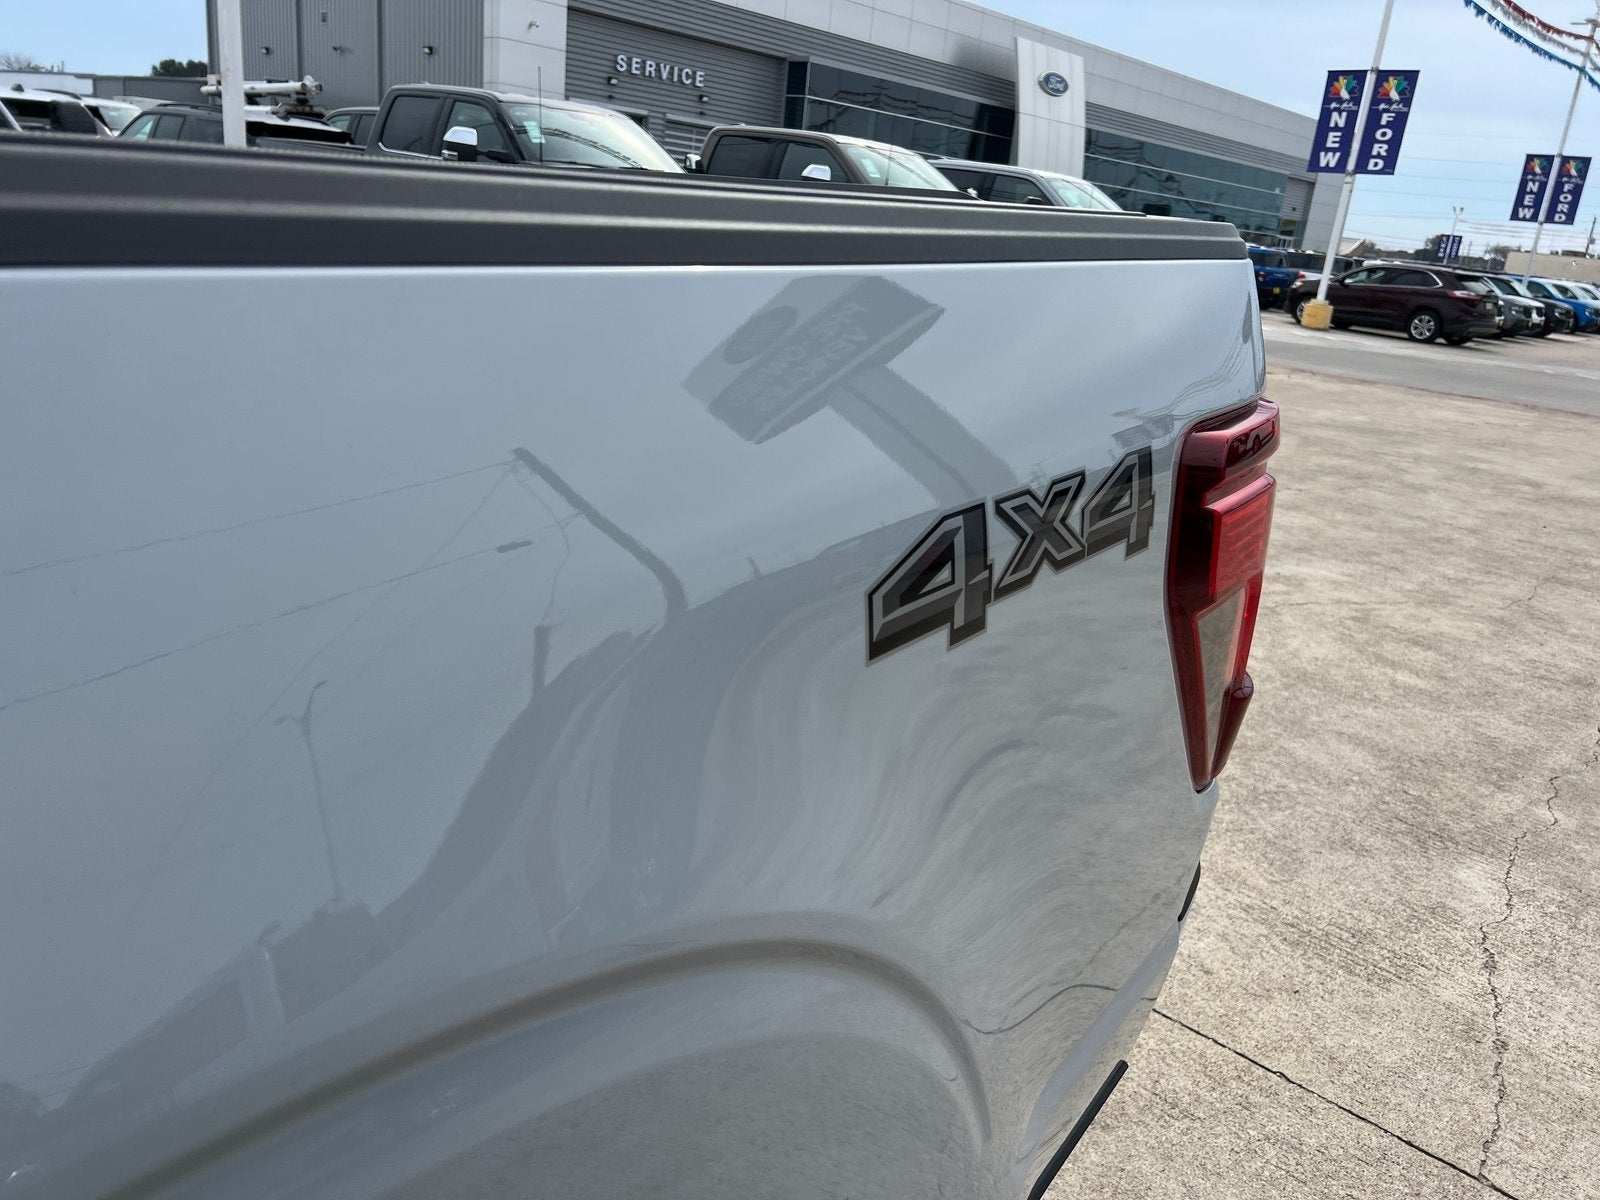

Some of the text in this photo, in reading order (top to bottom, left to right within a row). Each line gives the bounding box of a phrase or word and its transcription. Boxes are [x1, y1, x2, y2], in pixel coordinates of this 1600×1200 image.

[616, 54, 705, 87] SERVICE
[1319, 111, 1348, 168] NEW
[1367, 112, 1396, 170] FORD
[1518, 180, 1540, 219] NEW
[1554, 183, 1574, 222] FORD
